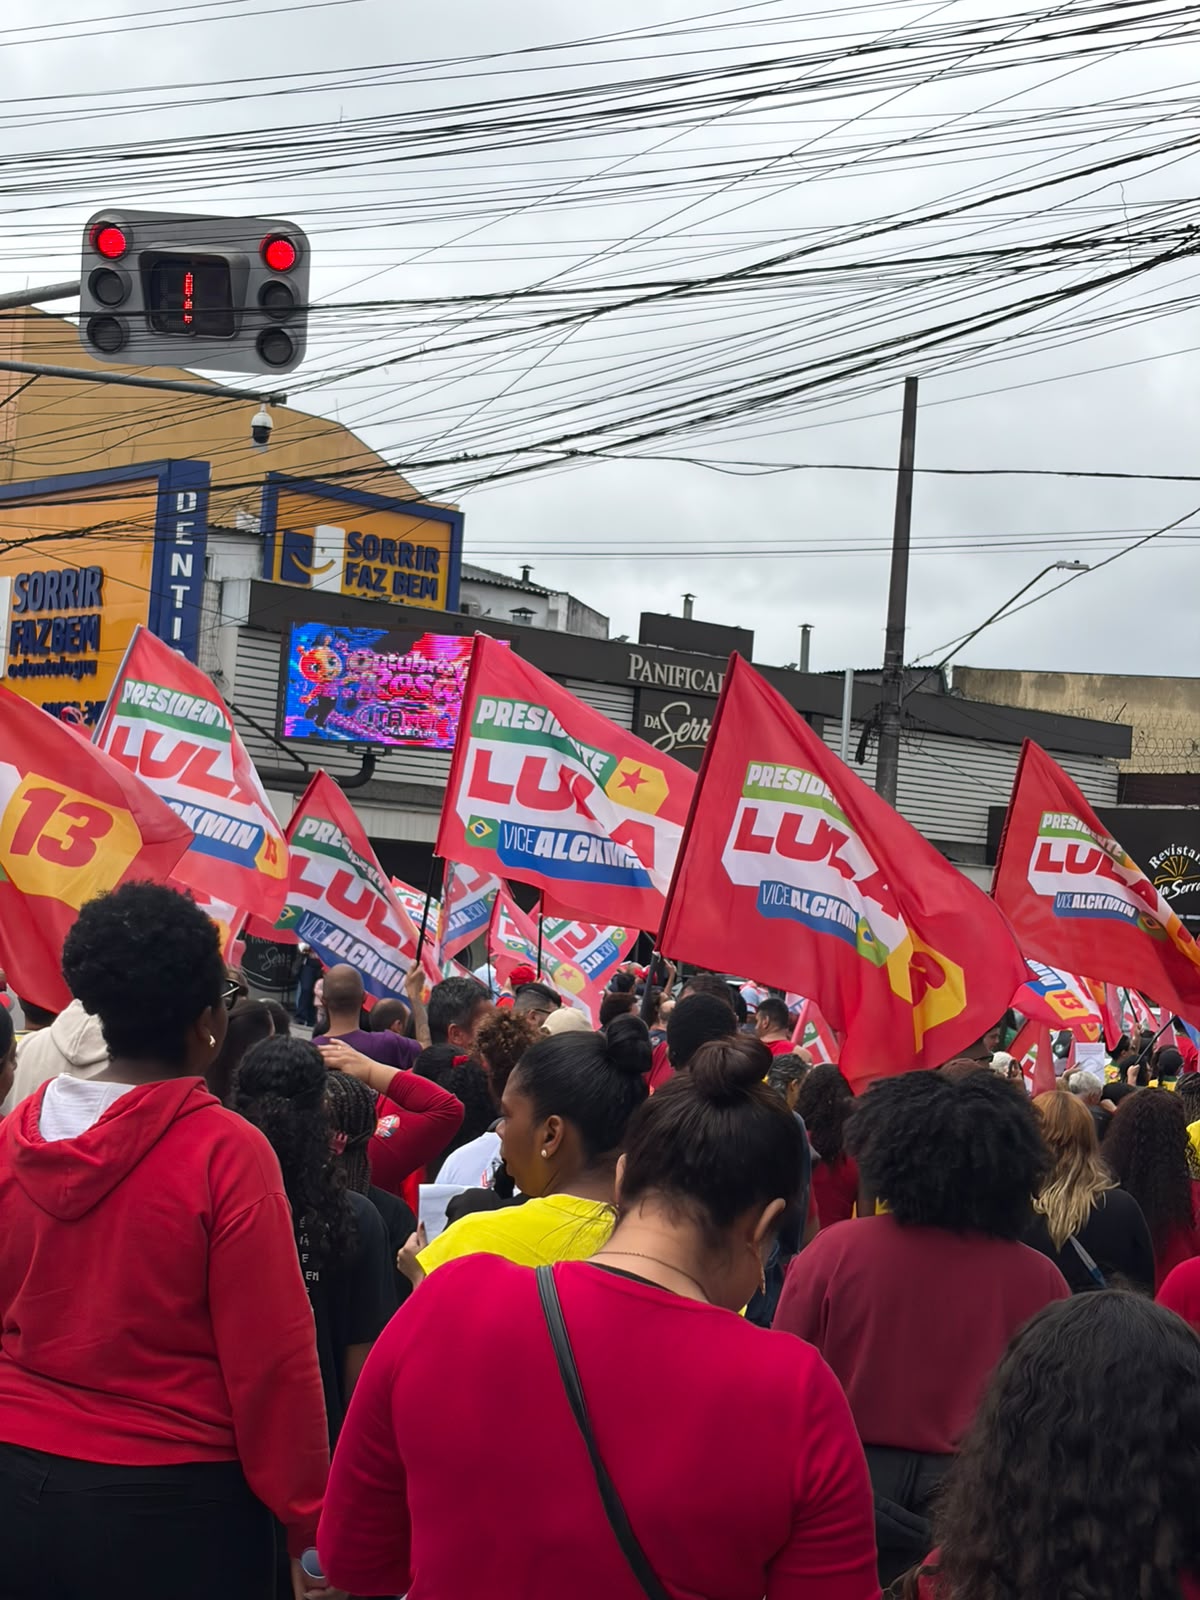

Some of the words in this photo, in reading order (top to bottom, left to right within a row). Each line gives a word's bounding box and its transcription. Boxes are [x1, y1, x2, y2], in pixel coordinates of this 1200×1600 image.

[346, 531, 440, 574] SORRIR
[13, 566, 104, 613] SORRIR
[170, 492, 197, 657] DENTI
[345, 562, 388, 592] FAZ
[392, 570, 439, 601] BEM
[122, 680, 230, 731] PRESIDENT
[644, 714, 661, 729] DA
[652, 701, 712, 753] Serr
[9, 787, 114, 867] 13
[504, 824, 537, 855] VICE
[1149, 843, 1200, 870] Revistar
[763, 883, 790, 907] VICE
[790, 888, 857, 934] ALCKMI
[1071, 893, 1136, 918] ALCKMIN
[300, 912, 334, 943] VICE
[1053, 991, 1084, 1010] 13
